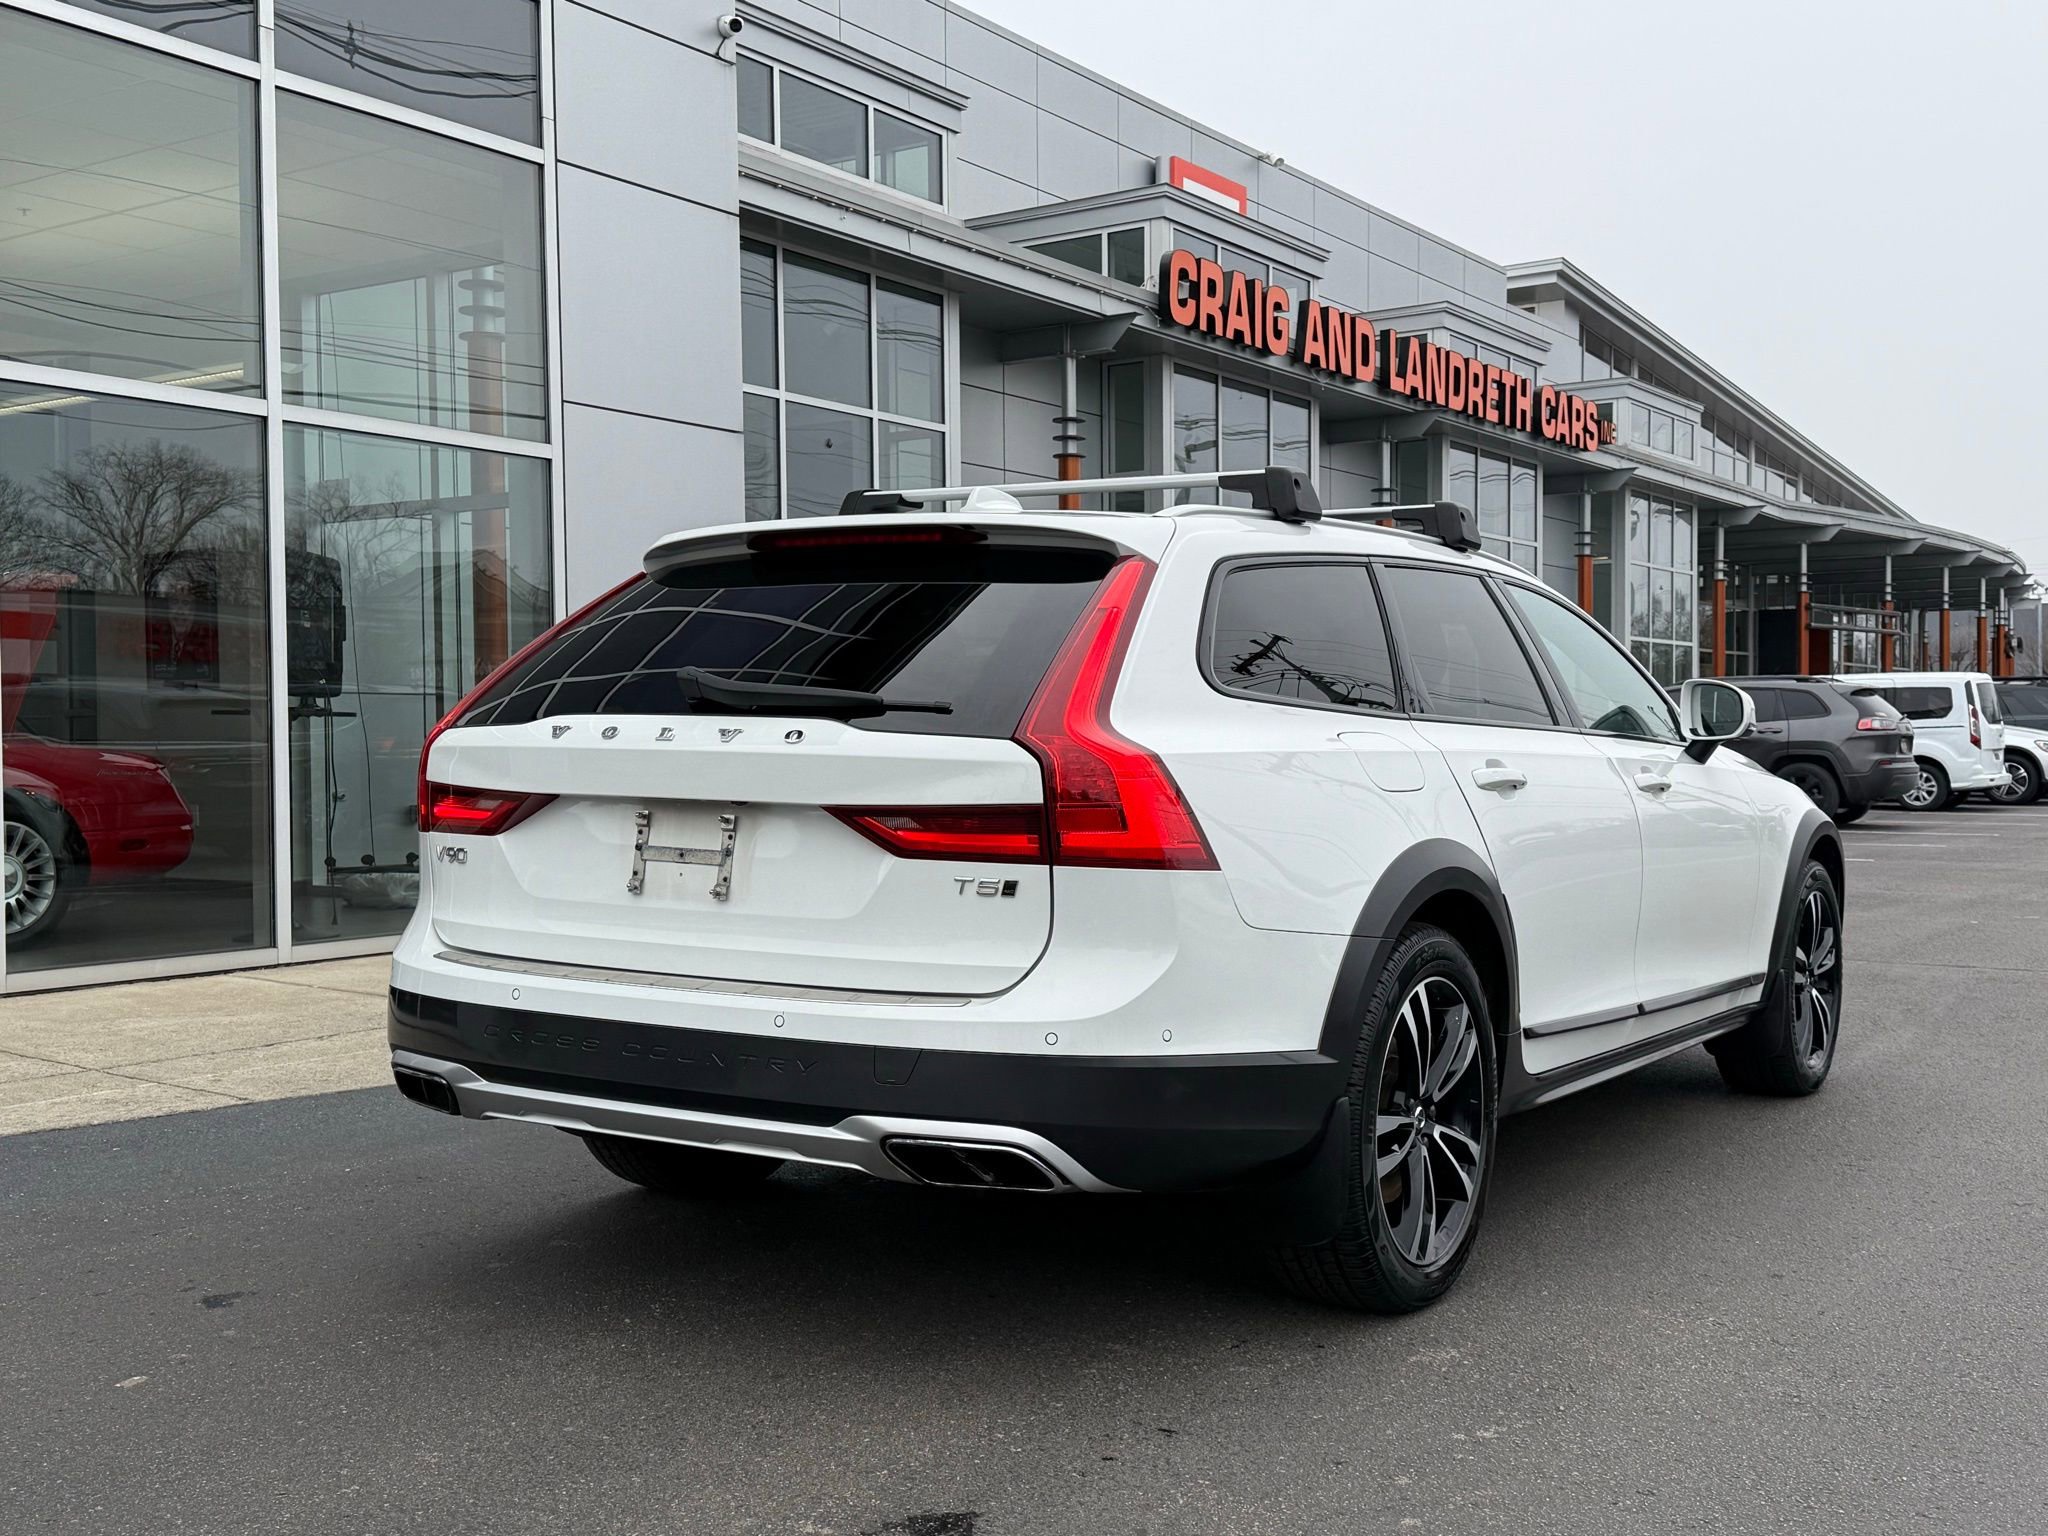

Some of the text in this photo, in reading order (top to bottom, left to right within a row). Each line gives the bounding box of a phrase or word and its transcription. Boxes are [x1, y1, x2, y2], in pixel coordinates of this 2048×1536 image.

[1166, 248, 1290, 356] CRAIG
[1302, 299, 1376, 383] AND
[1387, 329, 1532, 433] LANDRETH
[1540, 385, 1599, 452] CARS
[551, 725, 807, 744] VOLVO
[436, 845, 467, 864] V90
